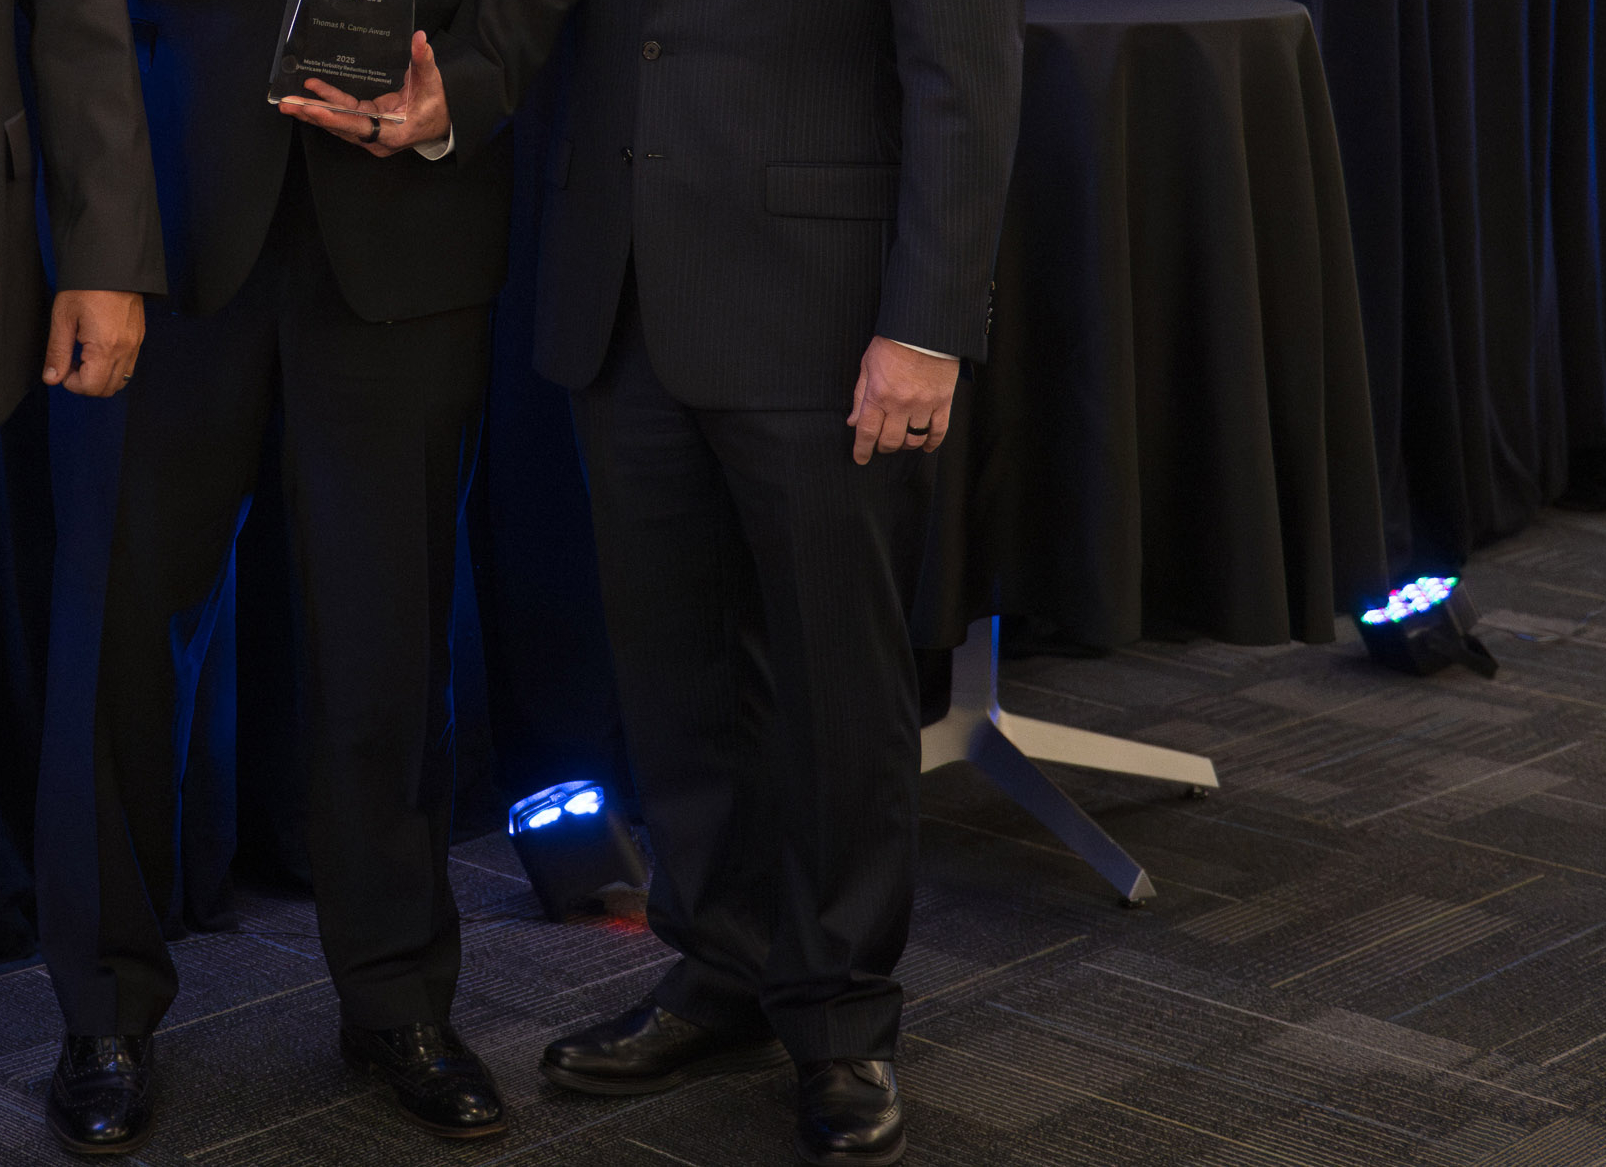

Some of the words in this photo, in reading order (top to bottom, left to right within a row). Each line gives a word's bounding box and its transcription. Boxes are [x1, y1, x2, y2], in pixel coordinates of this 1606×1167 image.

[312, 17, 339, 29] Thomas
[347, 23, 368, 34] Camp
[368, 27, 391, 37] Award
[336, 55, 355, 64] 2025
